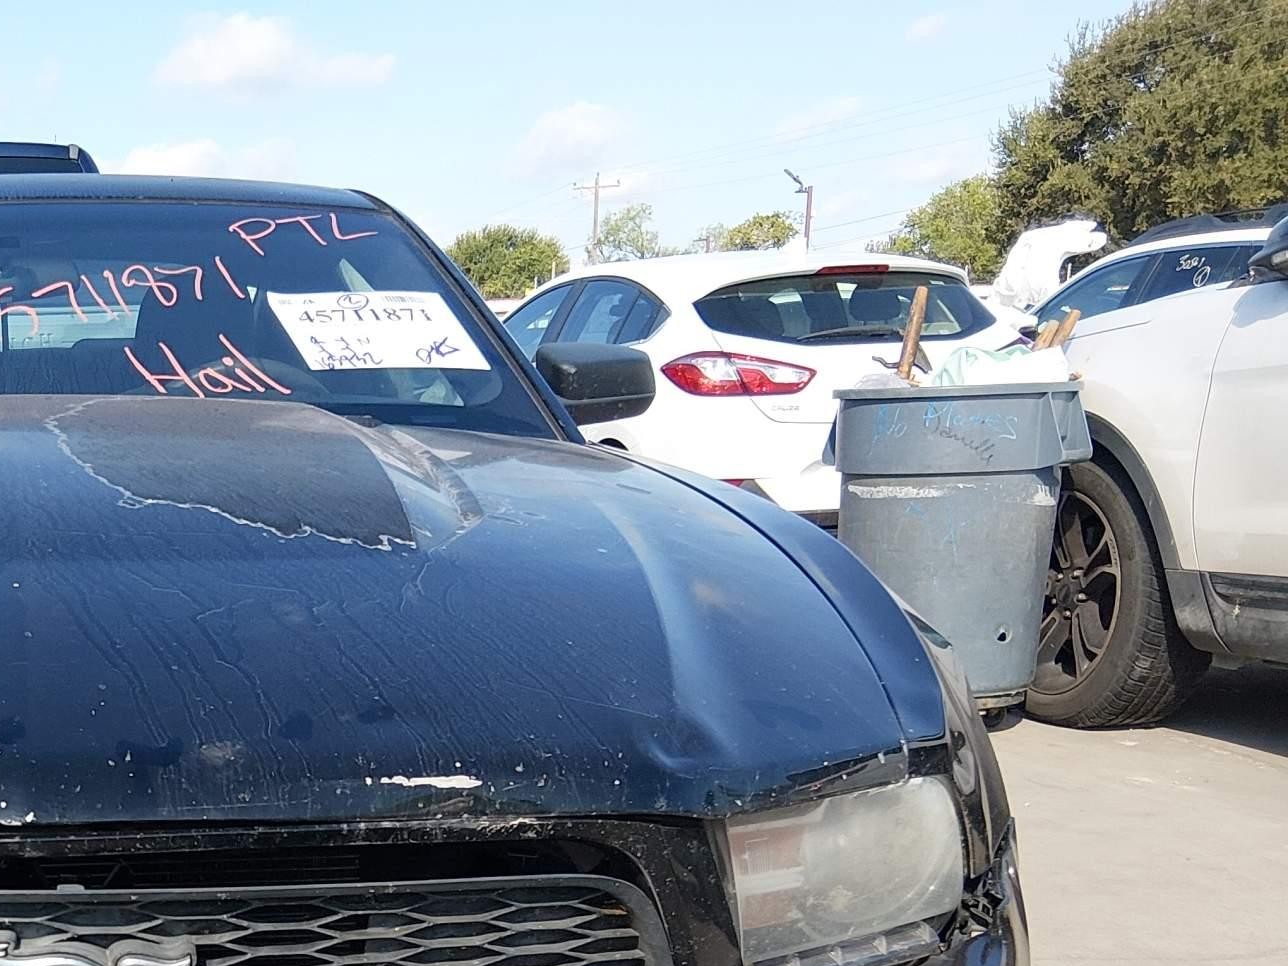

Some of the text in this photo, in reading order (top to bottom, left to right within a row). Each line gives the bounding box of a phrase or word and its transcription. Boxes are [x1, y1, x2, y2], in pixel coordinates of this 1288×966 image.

[228, 212, 379, 256] PTL
[298, 307, 433, 323] 45711871
[123, 333, 293, 399] Hail
